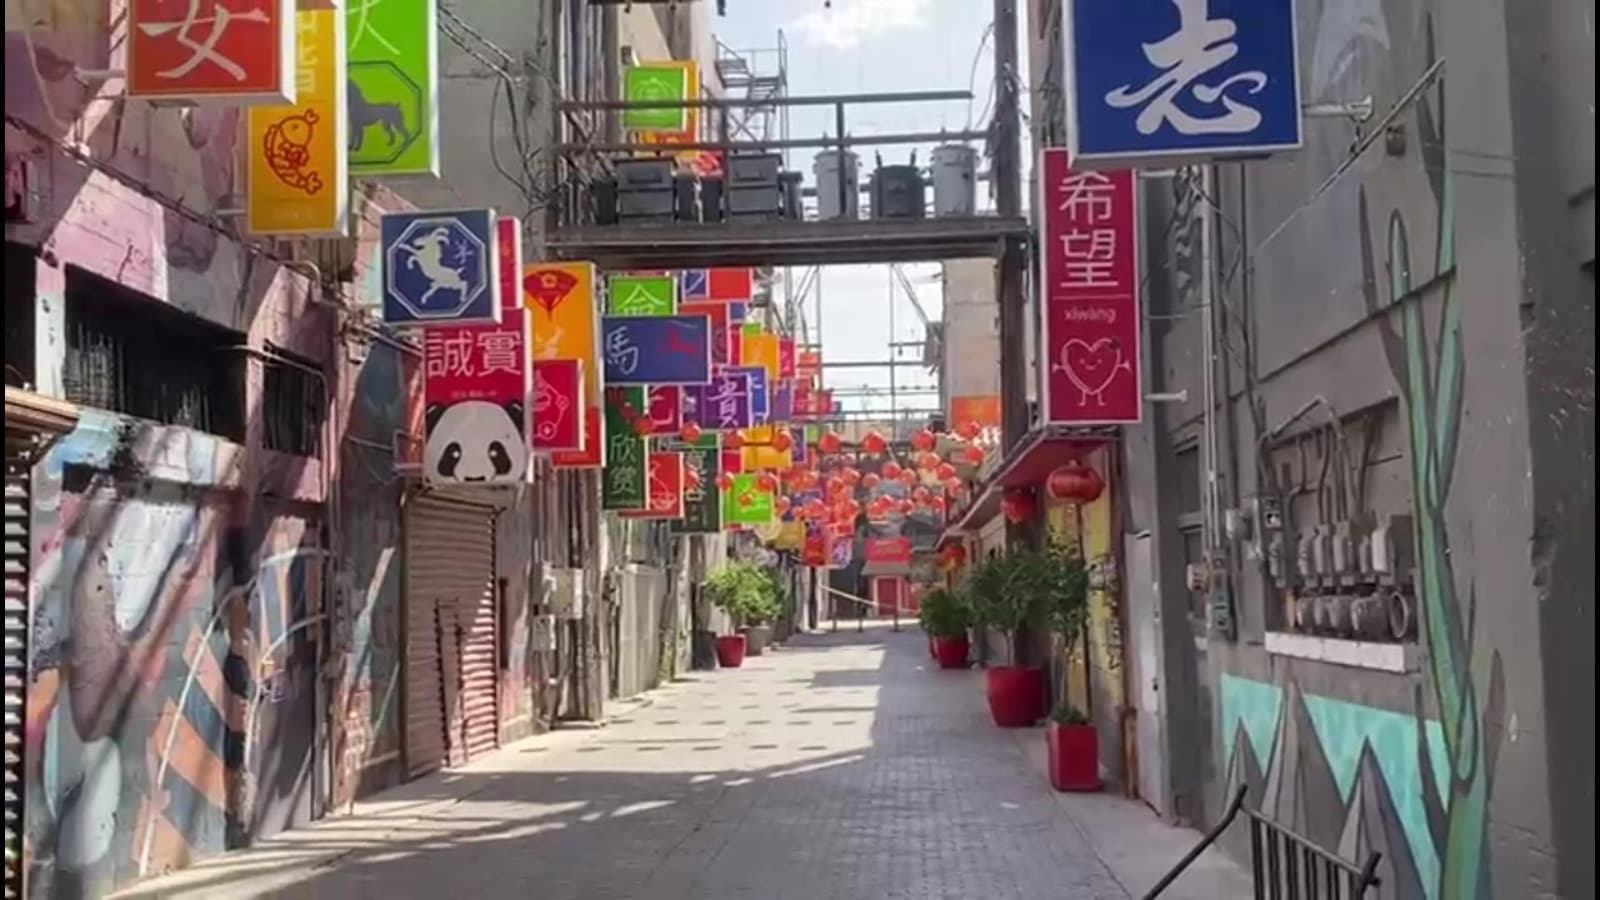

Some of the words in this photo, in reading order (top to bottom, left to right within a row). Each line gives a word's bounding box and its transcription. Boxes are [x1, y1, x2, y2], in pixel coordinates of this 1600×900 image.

[1059, 171, 1118, 289] 希望
[426, 329, 522, 378] 誠實
[606, 326, 638, 375] 馬
[707, 371, 746, 427] 貴
